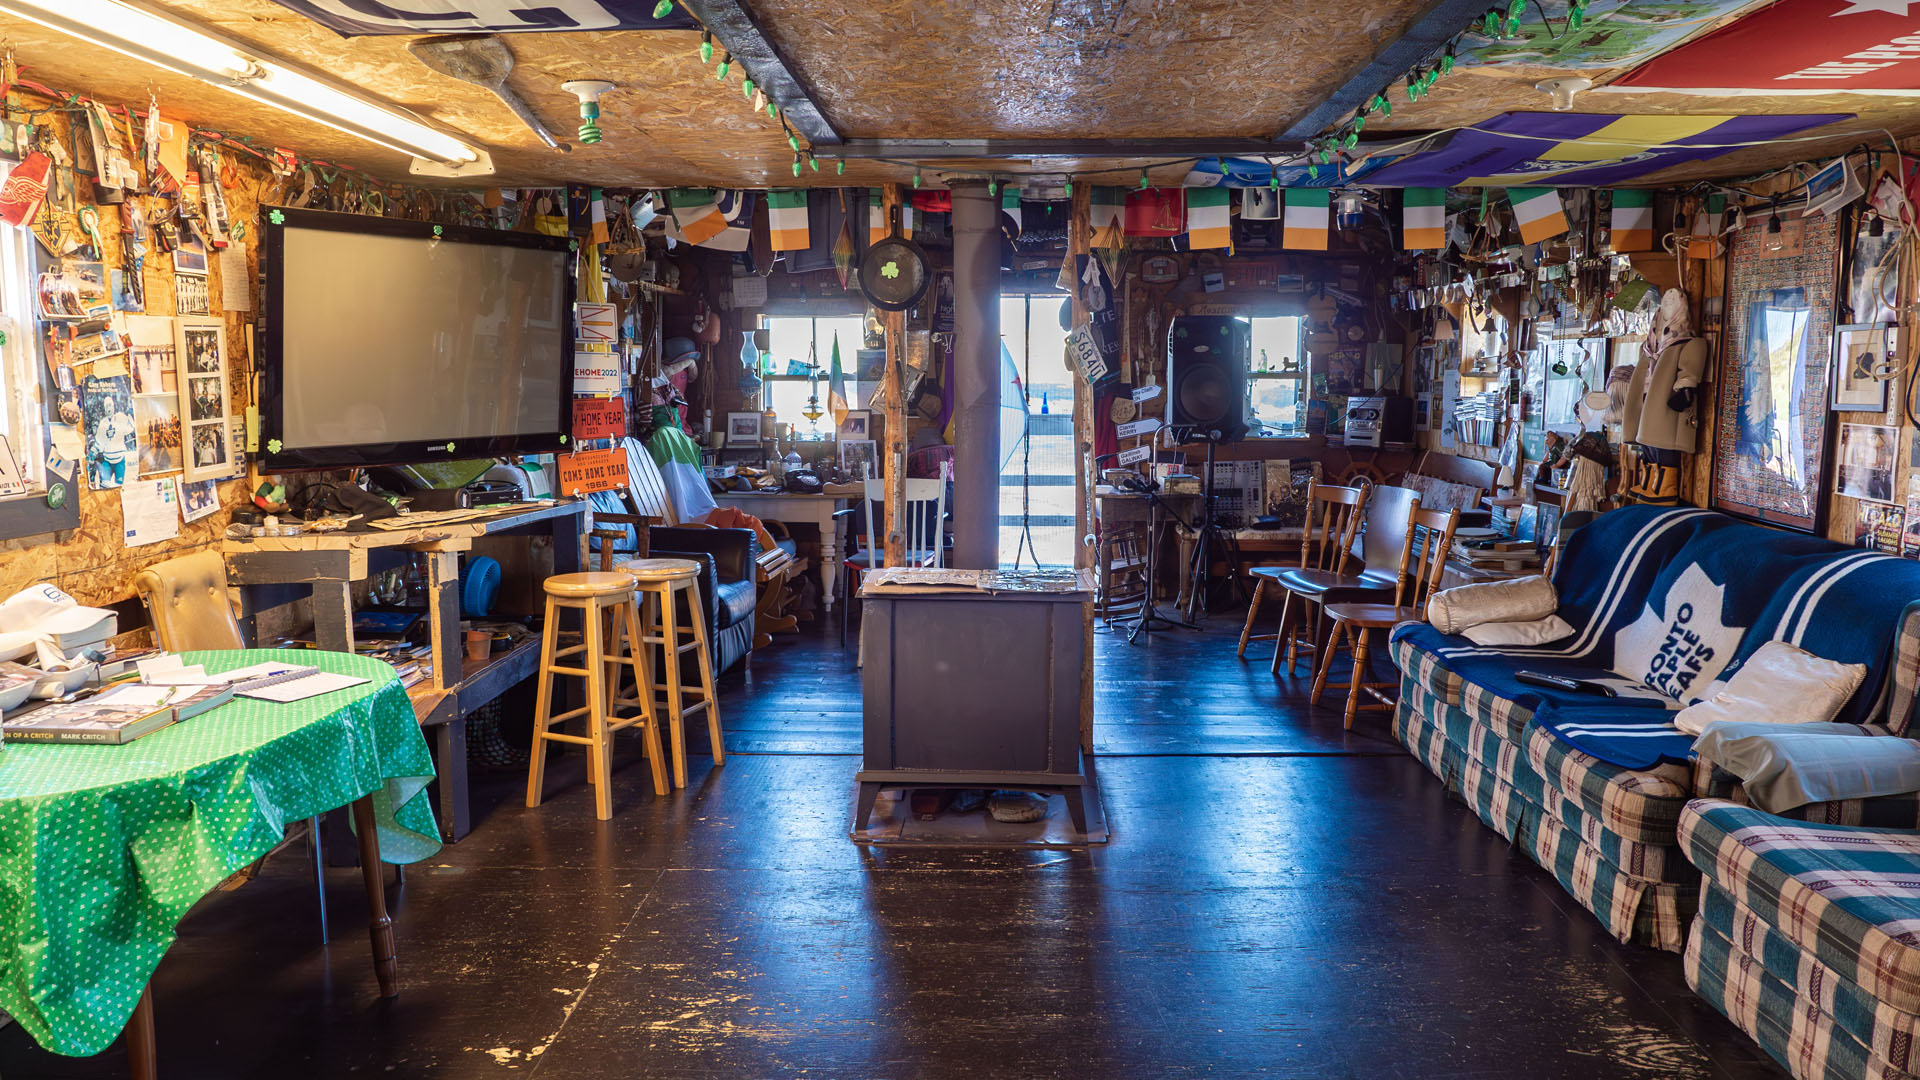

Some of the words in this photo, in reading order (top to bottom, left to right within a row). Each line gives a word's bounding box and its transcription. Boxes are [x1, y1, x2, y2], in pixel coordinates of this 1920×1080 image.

[1774, 61, 1901, 80] THE
[581, 413, 602, 427] HOME
[603, 411, 623, 425] YEAR
[563, 470, 582, 482] COME
[585, 467, 605, 479] HOME
[607, 464, 626, 476] YEAR
[585, 480, 608, 489] 1966
